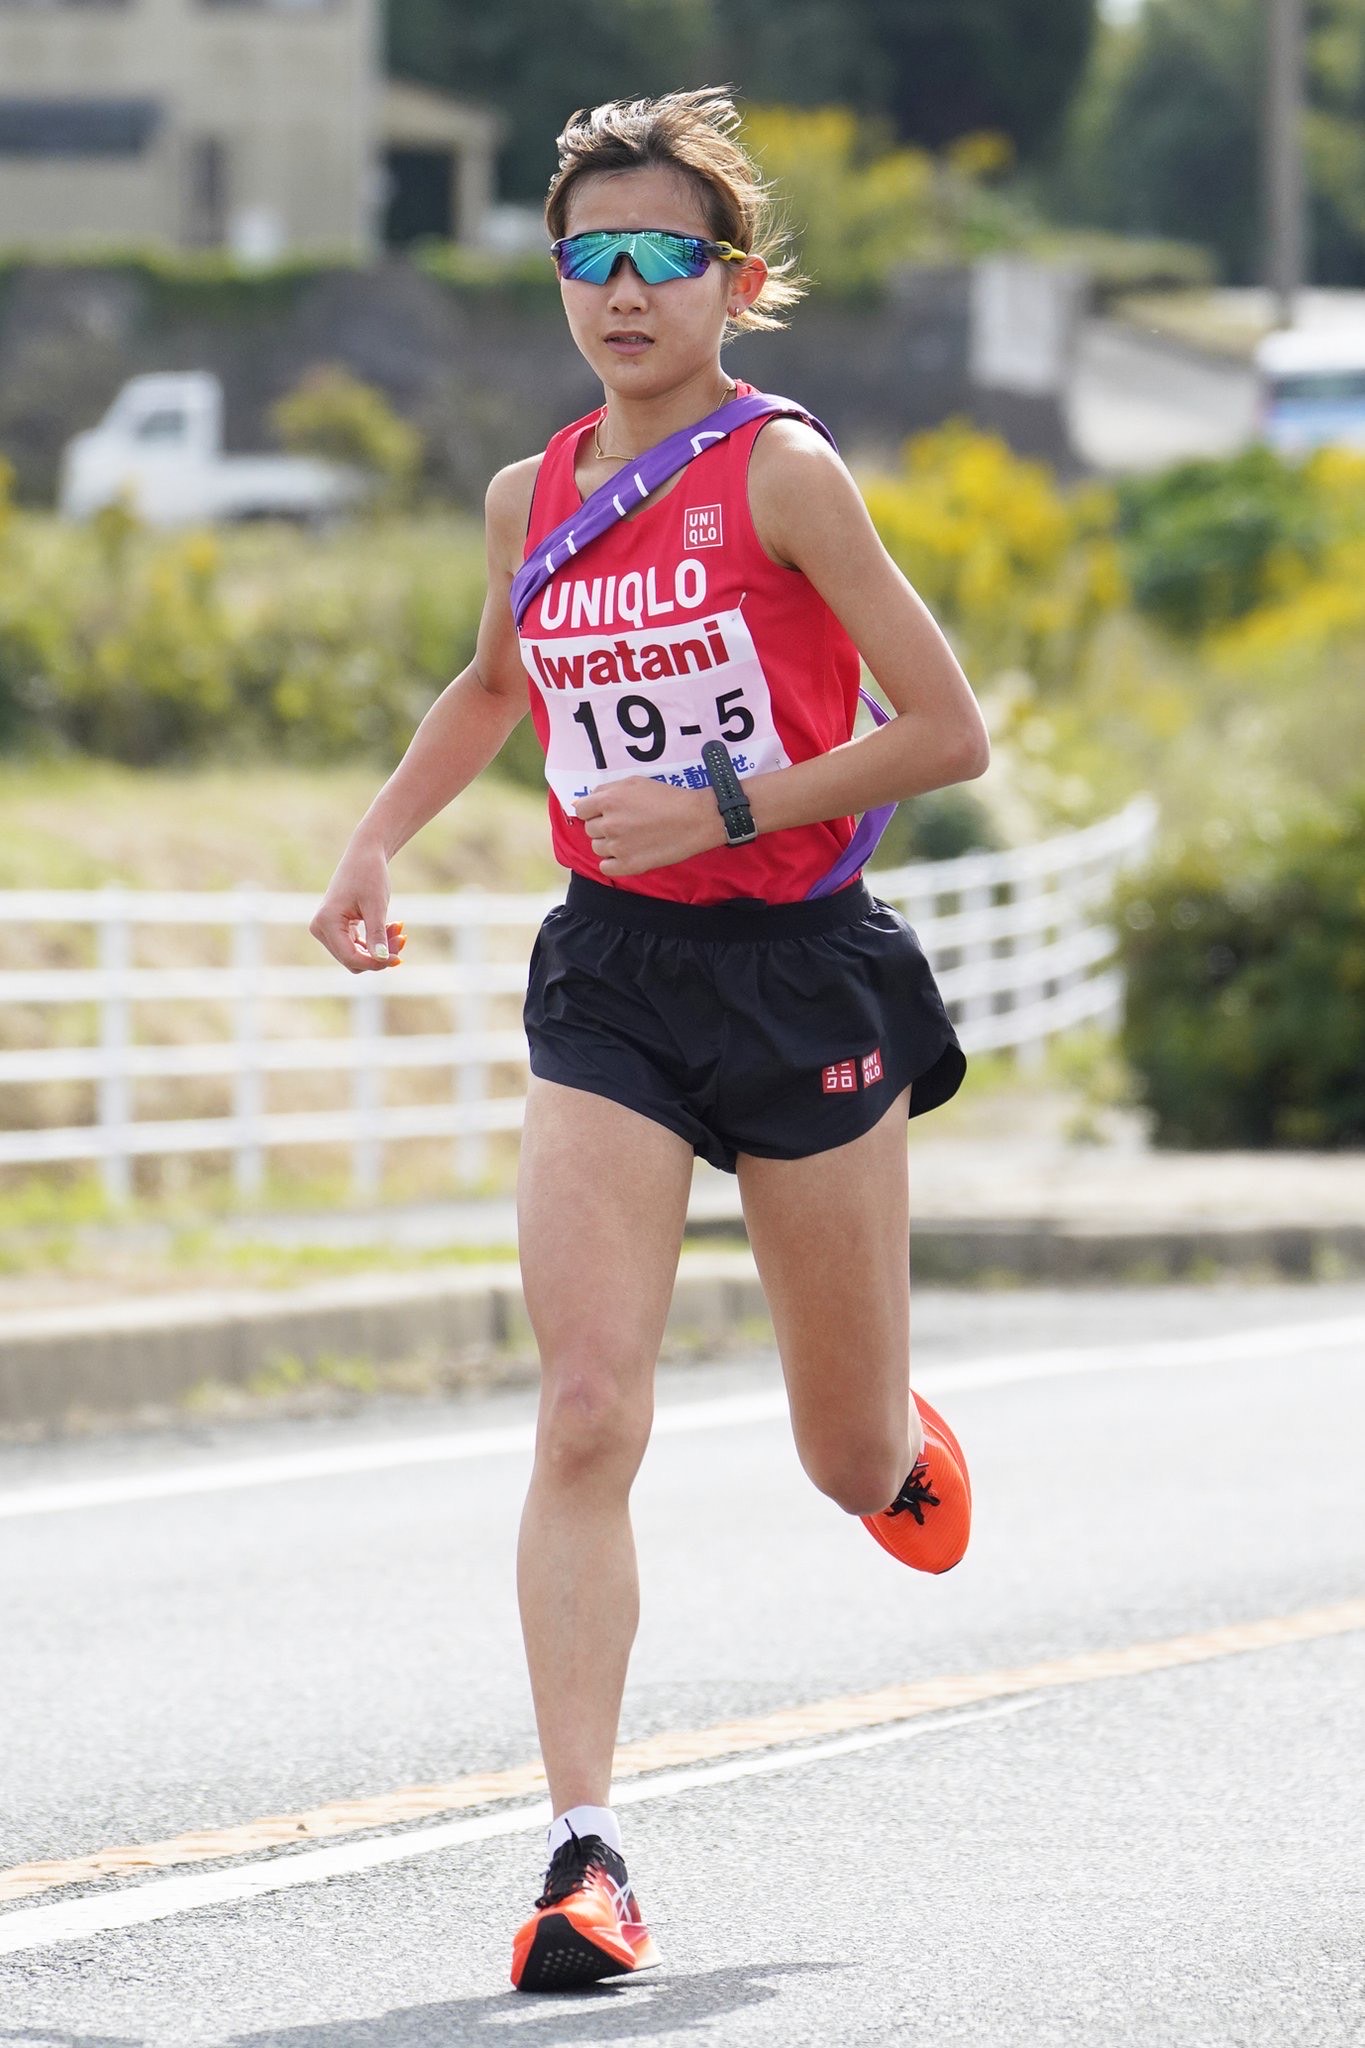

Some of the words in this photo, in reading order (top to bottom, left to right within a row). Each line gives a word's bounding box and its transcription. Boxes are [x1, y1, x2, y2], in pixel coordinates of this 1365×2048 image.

[690, 511, 714, 527] UNI
[689, 527, 717, 545] QLO
[540, 558, 707, 631] UNIQLO
[531, 619, 730, 690] Iwatani
[572, 687, 755, 770] 19-5
[863, 1053, 878, 1069] UNI
[864, 1065, 881, 1084] QLO
